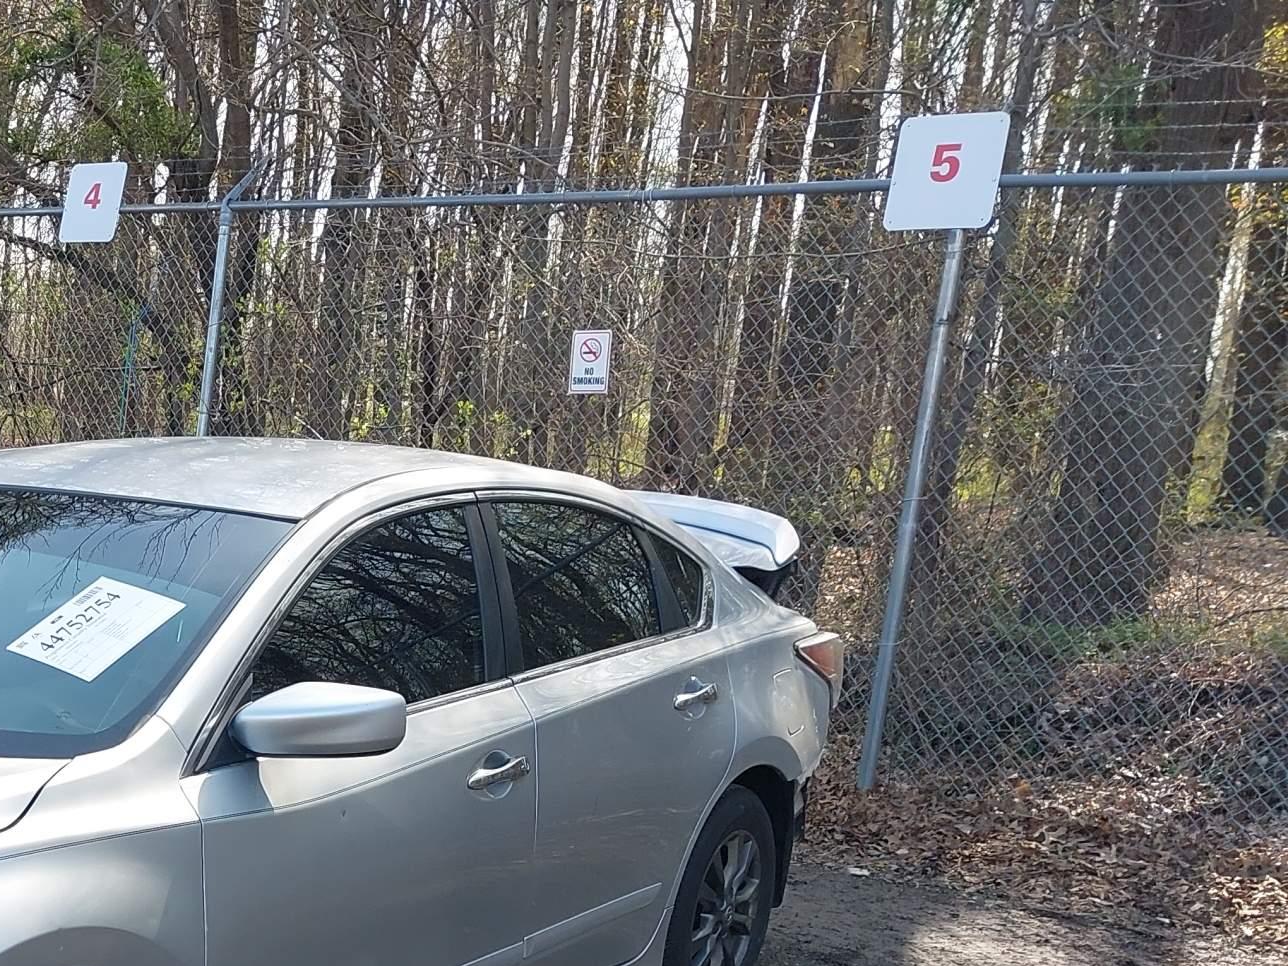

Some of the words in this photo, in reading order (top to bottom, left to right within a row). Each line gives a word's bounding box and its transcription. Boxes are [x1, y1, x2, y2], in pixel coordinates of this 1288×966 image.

[929, 144, 963, 183] 5
[83, 183, 102, 210] 4
[572, 377, 605, 386] SMOKING
[584, 367, 594, 376] NO
[40, 591, 121, 652] 44752754
